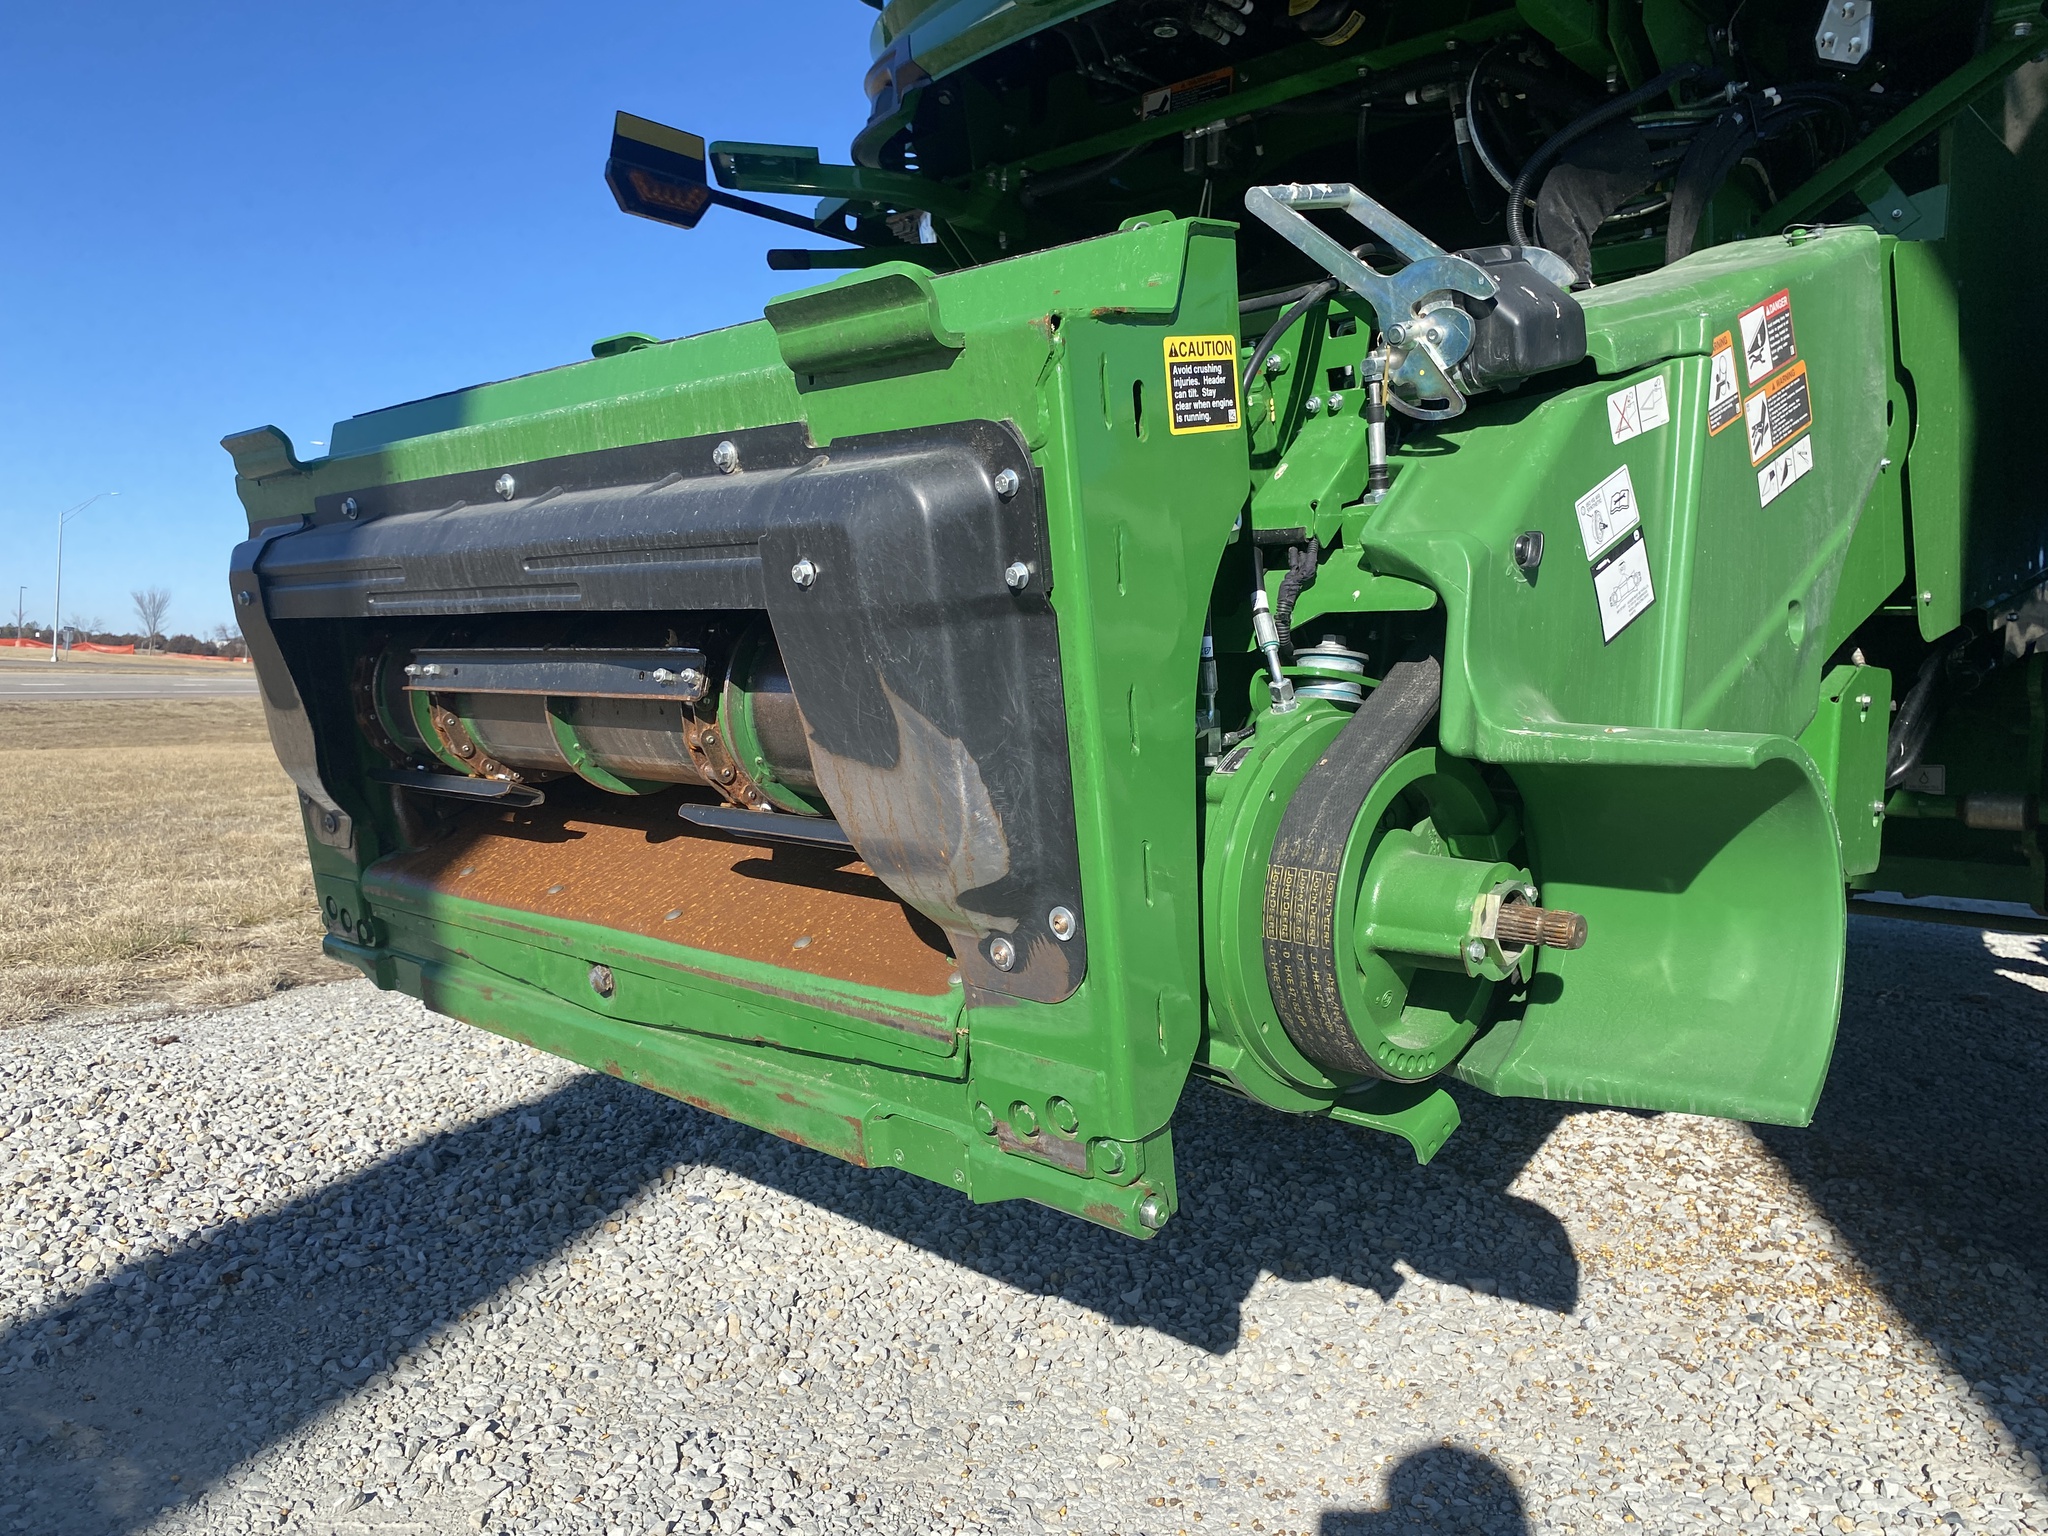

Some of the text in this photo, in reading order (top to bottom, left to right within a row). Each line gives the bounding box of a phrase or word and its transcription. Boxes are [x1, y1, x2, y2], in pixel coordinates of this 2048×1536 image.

[1769, 295, 1788, 315] DANGER
[1179, 340, 1233, 357] CAUTION
[1173, 363, 1222, 375] Avoid crushing
[1775, 368, 1796, 388] WARNING
[1173, 375, 1226, 388] injuries. Header
[1174, 387, 1217, 399] can tilt. Stay
[1175, 398, 1234, 411] clear when engine
[1176, 411, 1211, 423] is running.
[1297, 871, 1308, 902] JOHN
[1268, 868, 1280, 936] JOHN DEERE
[1281, 870, 1294, 939] JOHN DEERE
[1309, 874, 1322, 945] JOHN DEERE
